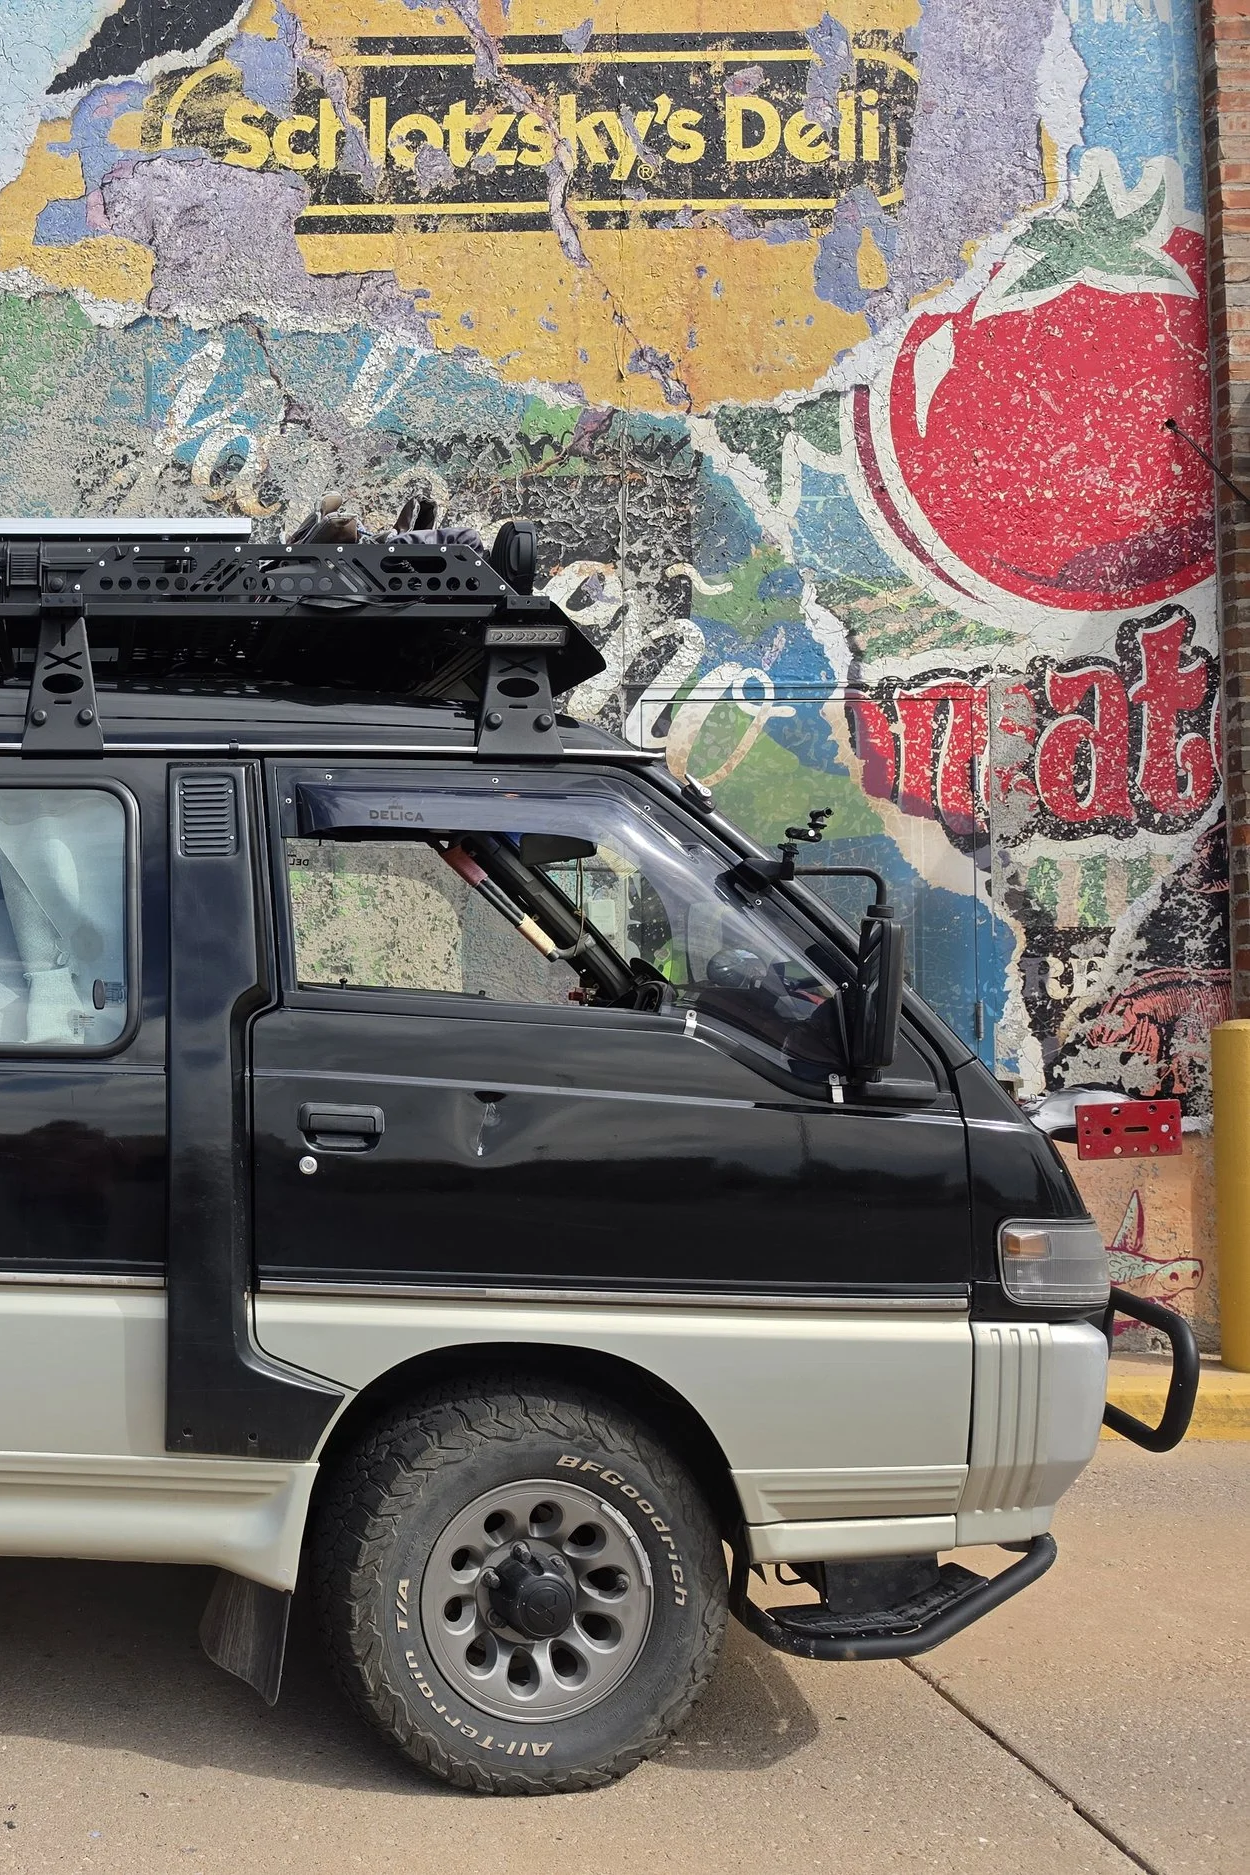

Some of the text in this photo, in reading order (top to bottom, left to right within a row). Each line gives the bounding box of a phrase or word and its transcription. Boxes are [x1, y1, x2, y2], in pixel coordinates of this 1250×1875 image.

[222, 89, 879, 181] Schlotzsky's Deli
[368, 809, 425, 823] DELICA
[556, 1453, 688, 1607] BFGoodrich
[395, 1578, 410, 1634] T/A
[405, 1649, 554, 1758] All-Terrain
